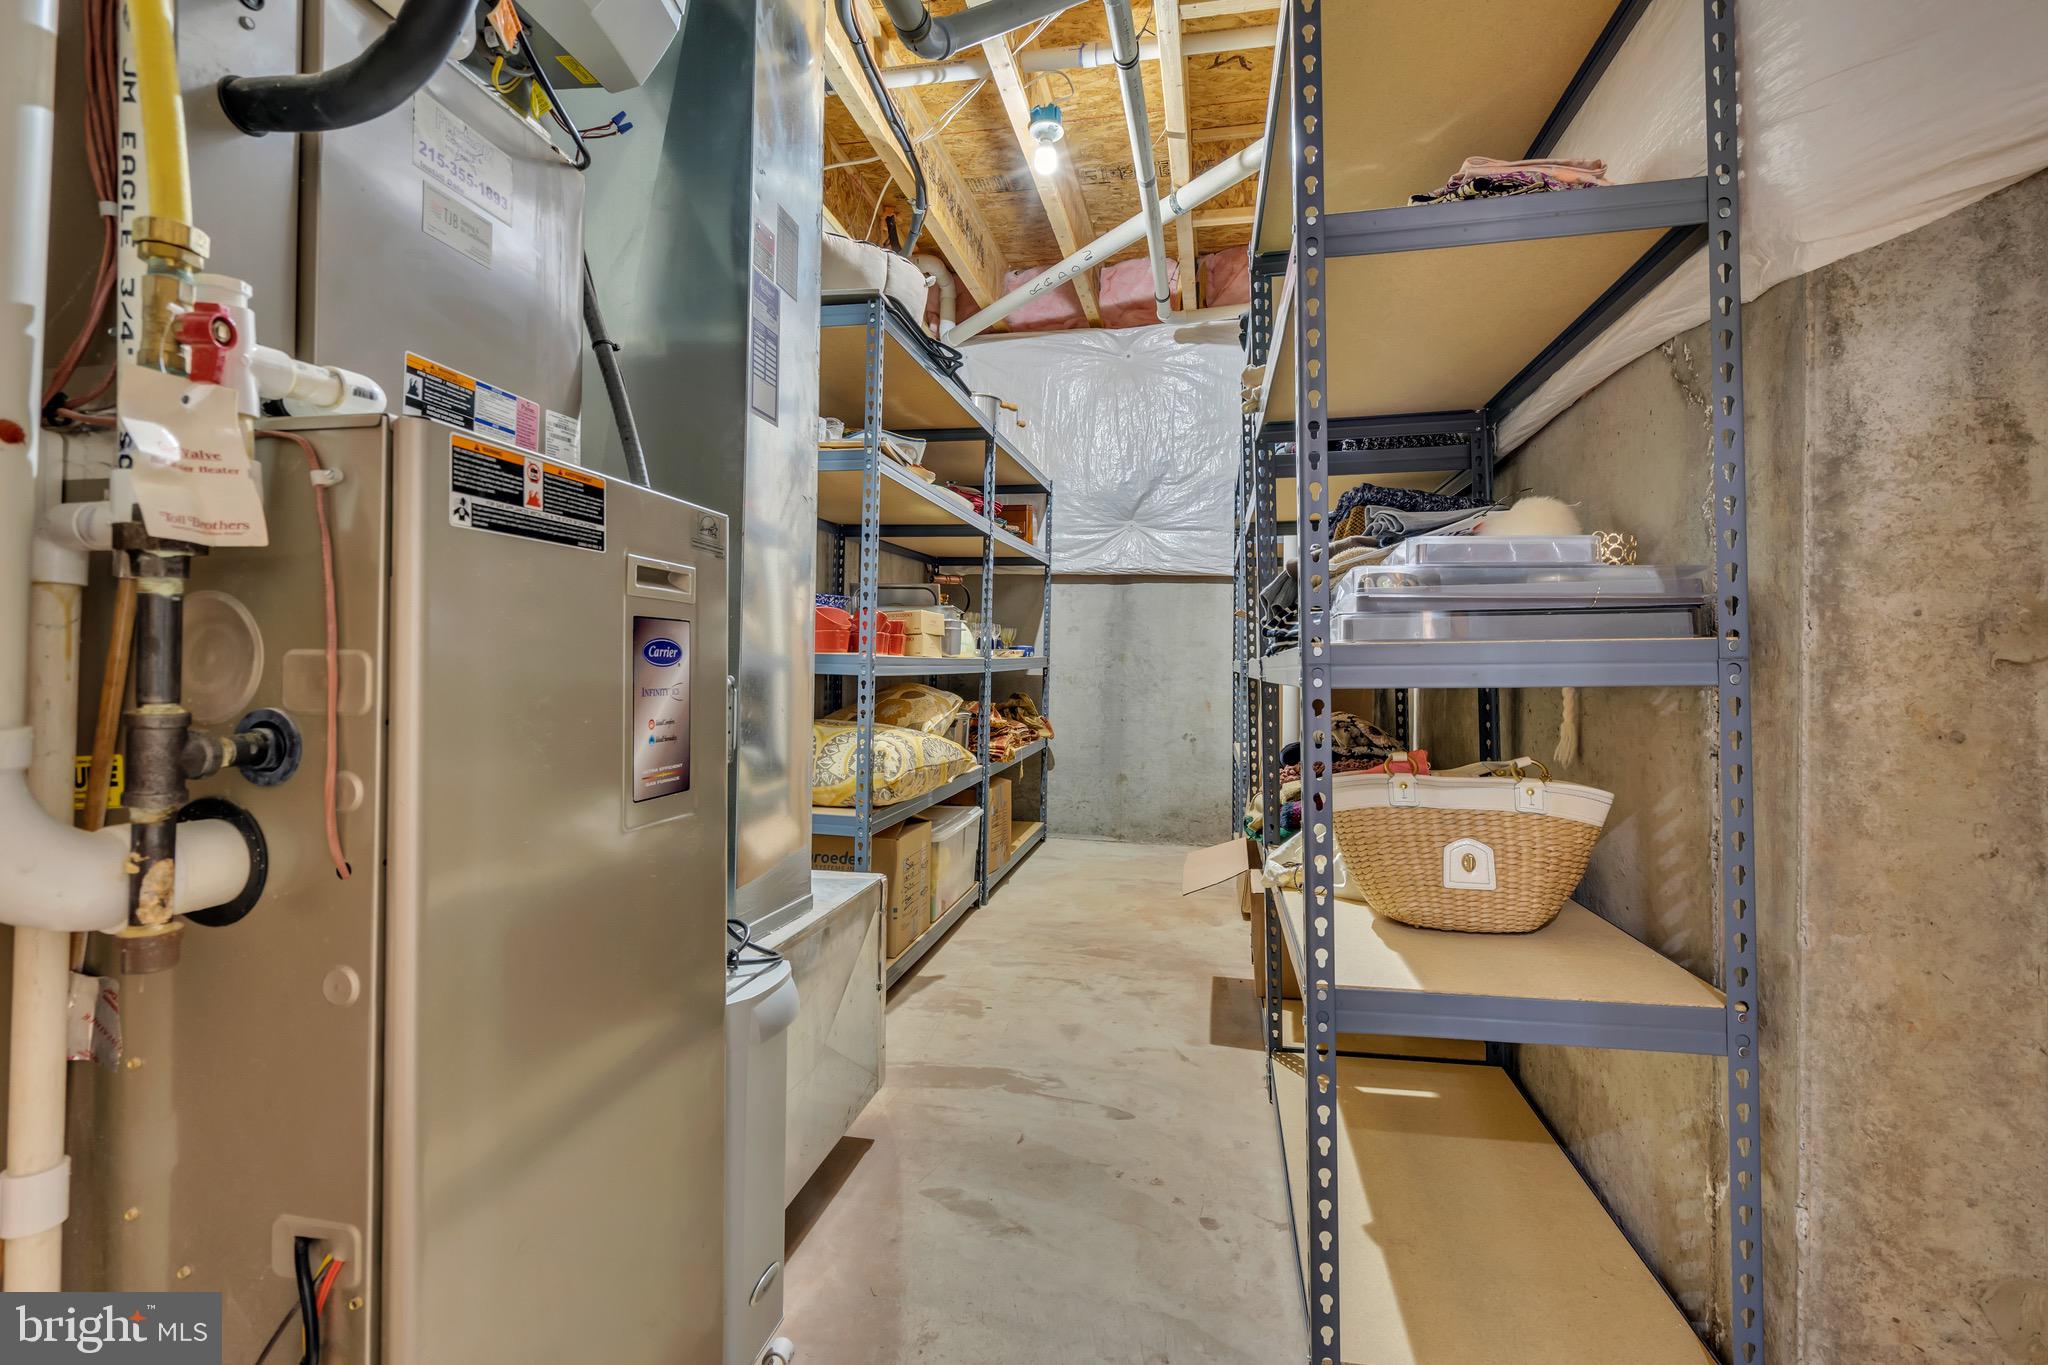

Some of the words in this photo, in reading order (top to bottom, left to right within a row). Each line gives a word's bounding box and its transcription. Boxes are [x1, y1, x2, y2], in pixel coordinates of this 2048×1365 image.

[122, 58, 137, 104] JM
[418, 140, 508, 211] 215-355-1893
[121, 131, 136, 248] EAGLE
[181, 447, 222, 461] Valve
[199, 466, 240, 475] Heater
[159, 511, 186, 525] Toll
[187, 515, 250, 530] Brothers
[648, 645, 678, 658] Carrier
